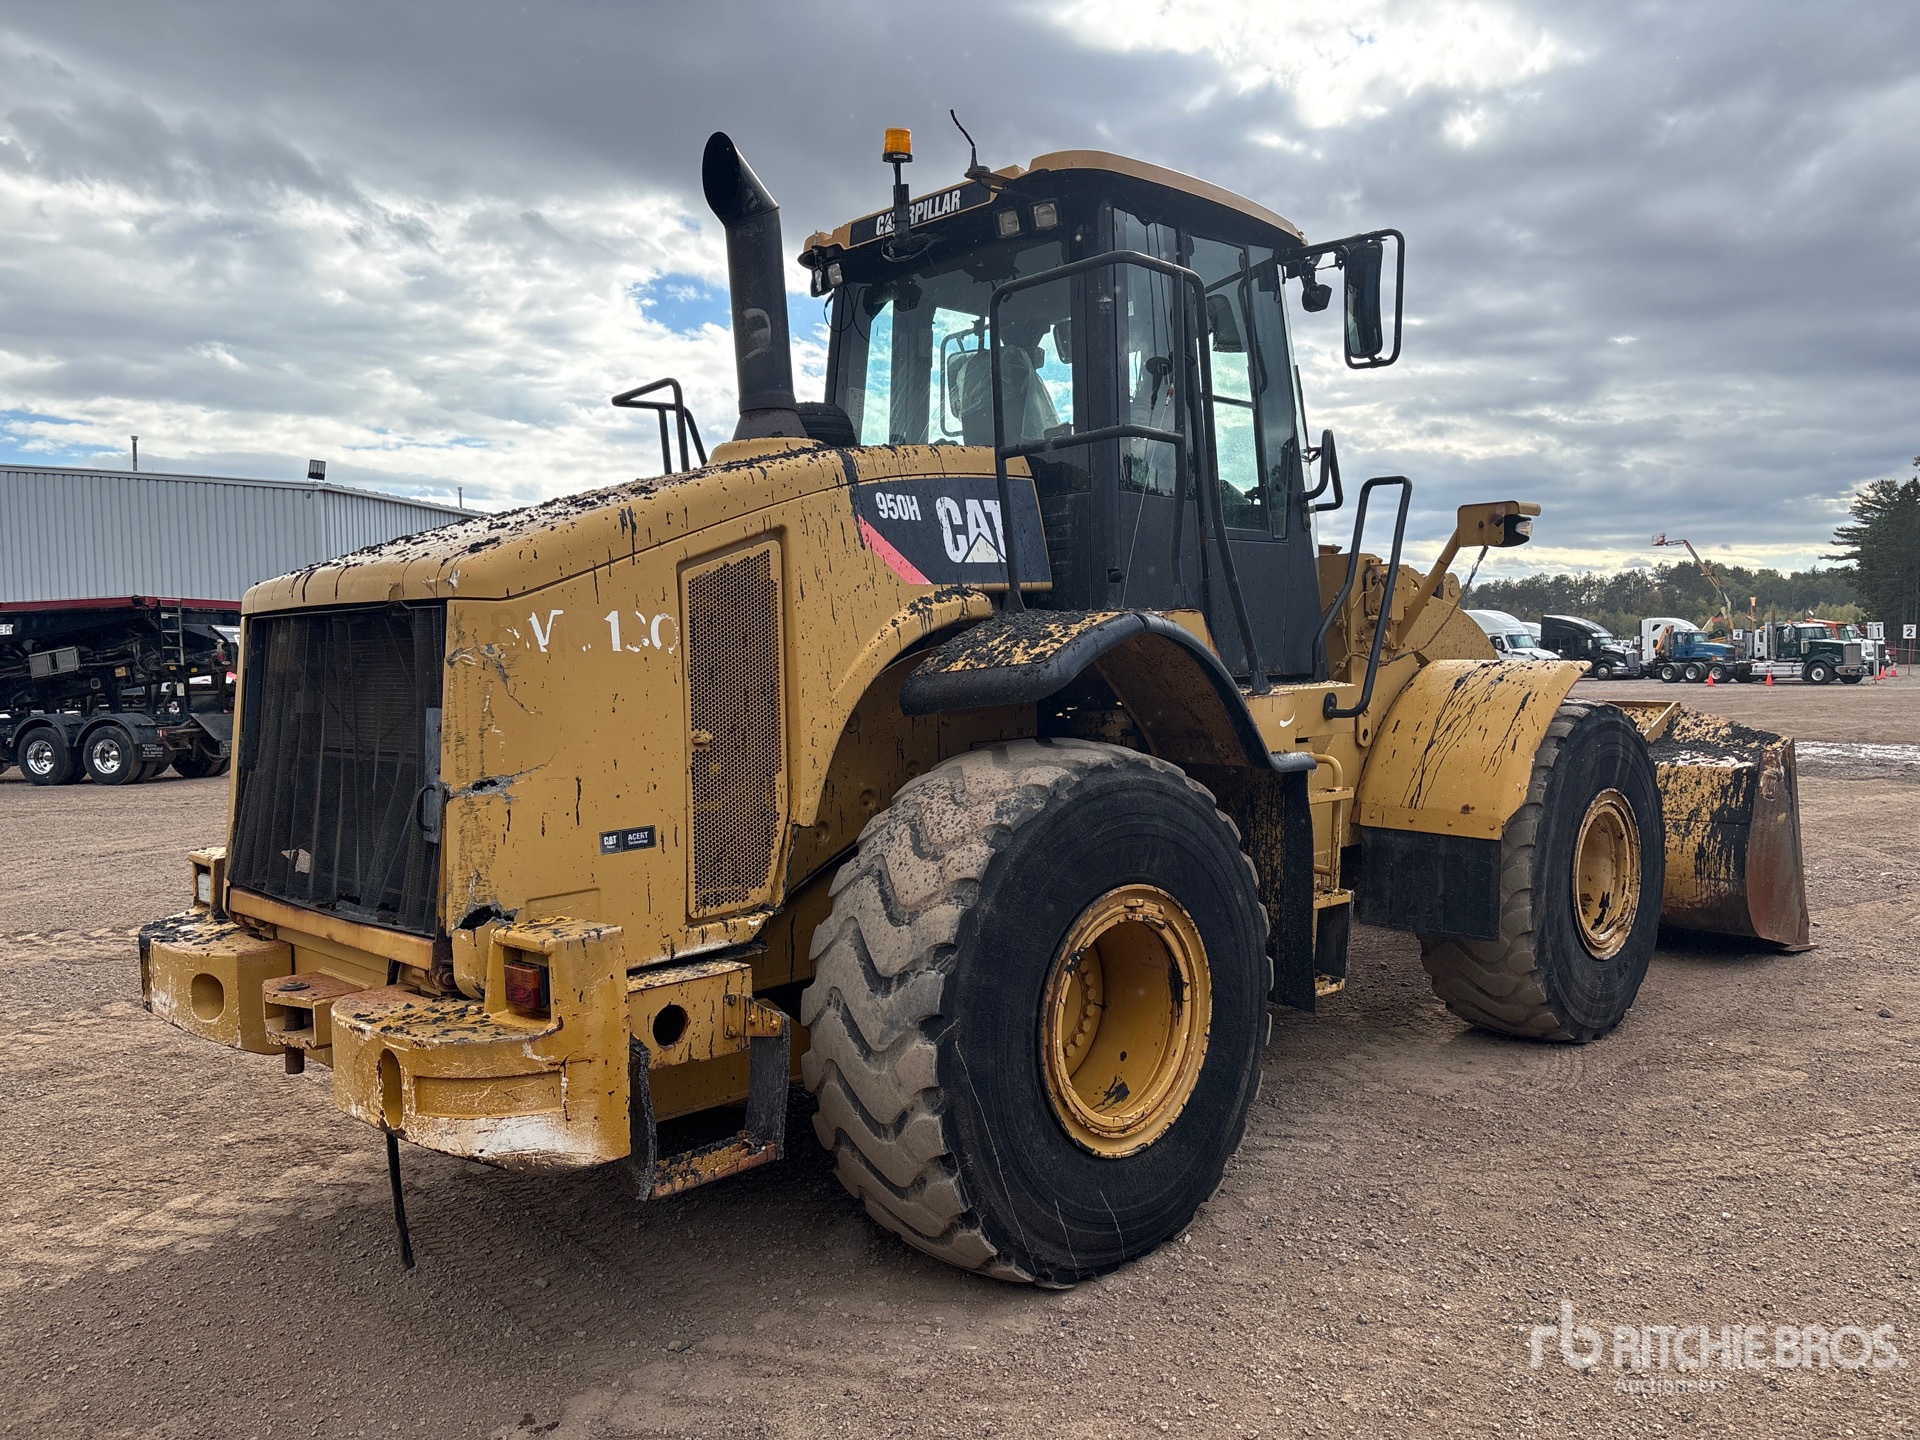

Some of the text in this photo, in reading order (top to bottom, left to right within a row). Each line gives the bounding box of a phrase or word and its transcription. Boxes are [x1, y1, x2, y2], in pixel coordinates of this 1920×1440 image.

[875, 189, 961, 236] CARPILLAR
[875, 492, 922, 521] 950H
[935, 496, 1007, 563] CAT
[1876, 627, 1880, 638] 1
[1906, 628, 1913, 637] 2
[604, 836, 617, 846] CAT
[628, 831, 648, 841] ACERT
